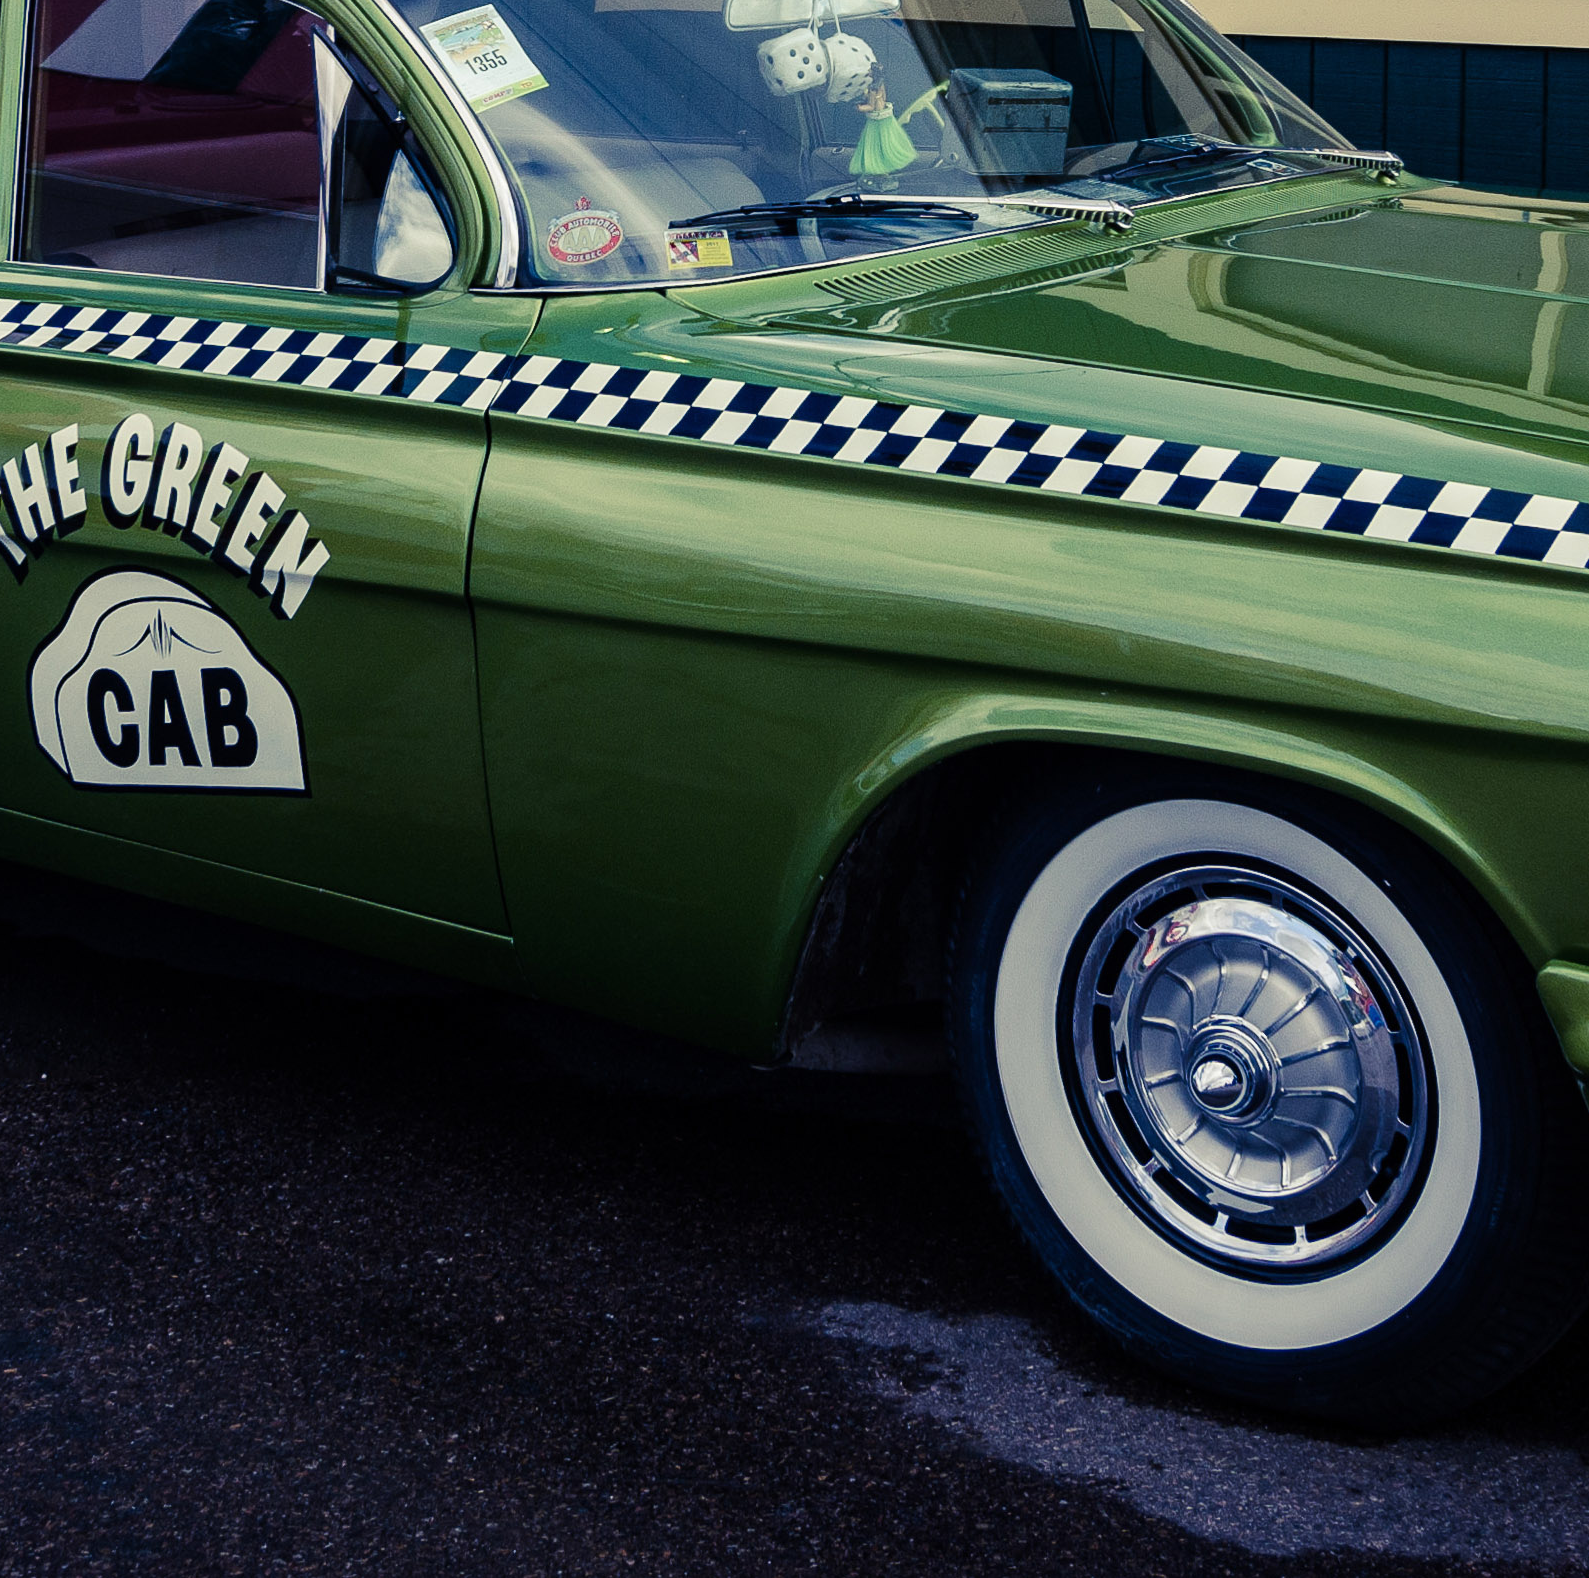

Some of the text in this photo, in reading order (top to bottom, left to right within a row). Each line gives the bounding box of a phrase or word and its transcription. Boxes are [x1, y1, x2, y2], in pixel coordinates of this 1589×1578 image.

[464, 48, 508, 75] 1355
[549, 217, 621, 248] CLUB AUTOMOBILE
[566, 249, 603, 263] QUEBEC
[102, 412, 332, 622] GREEN
[86, 666, 260, 771] CAB
